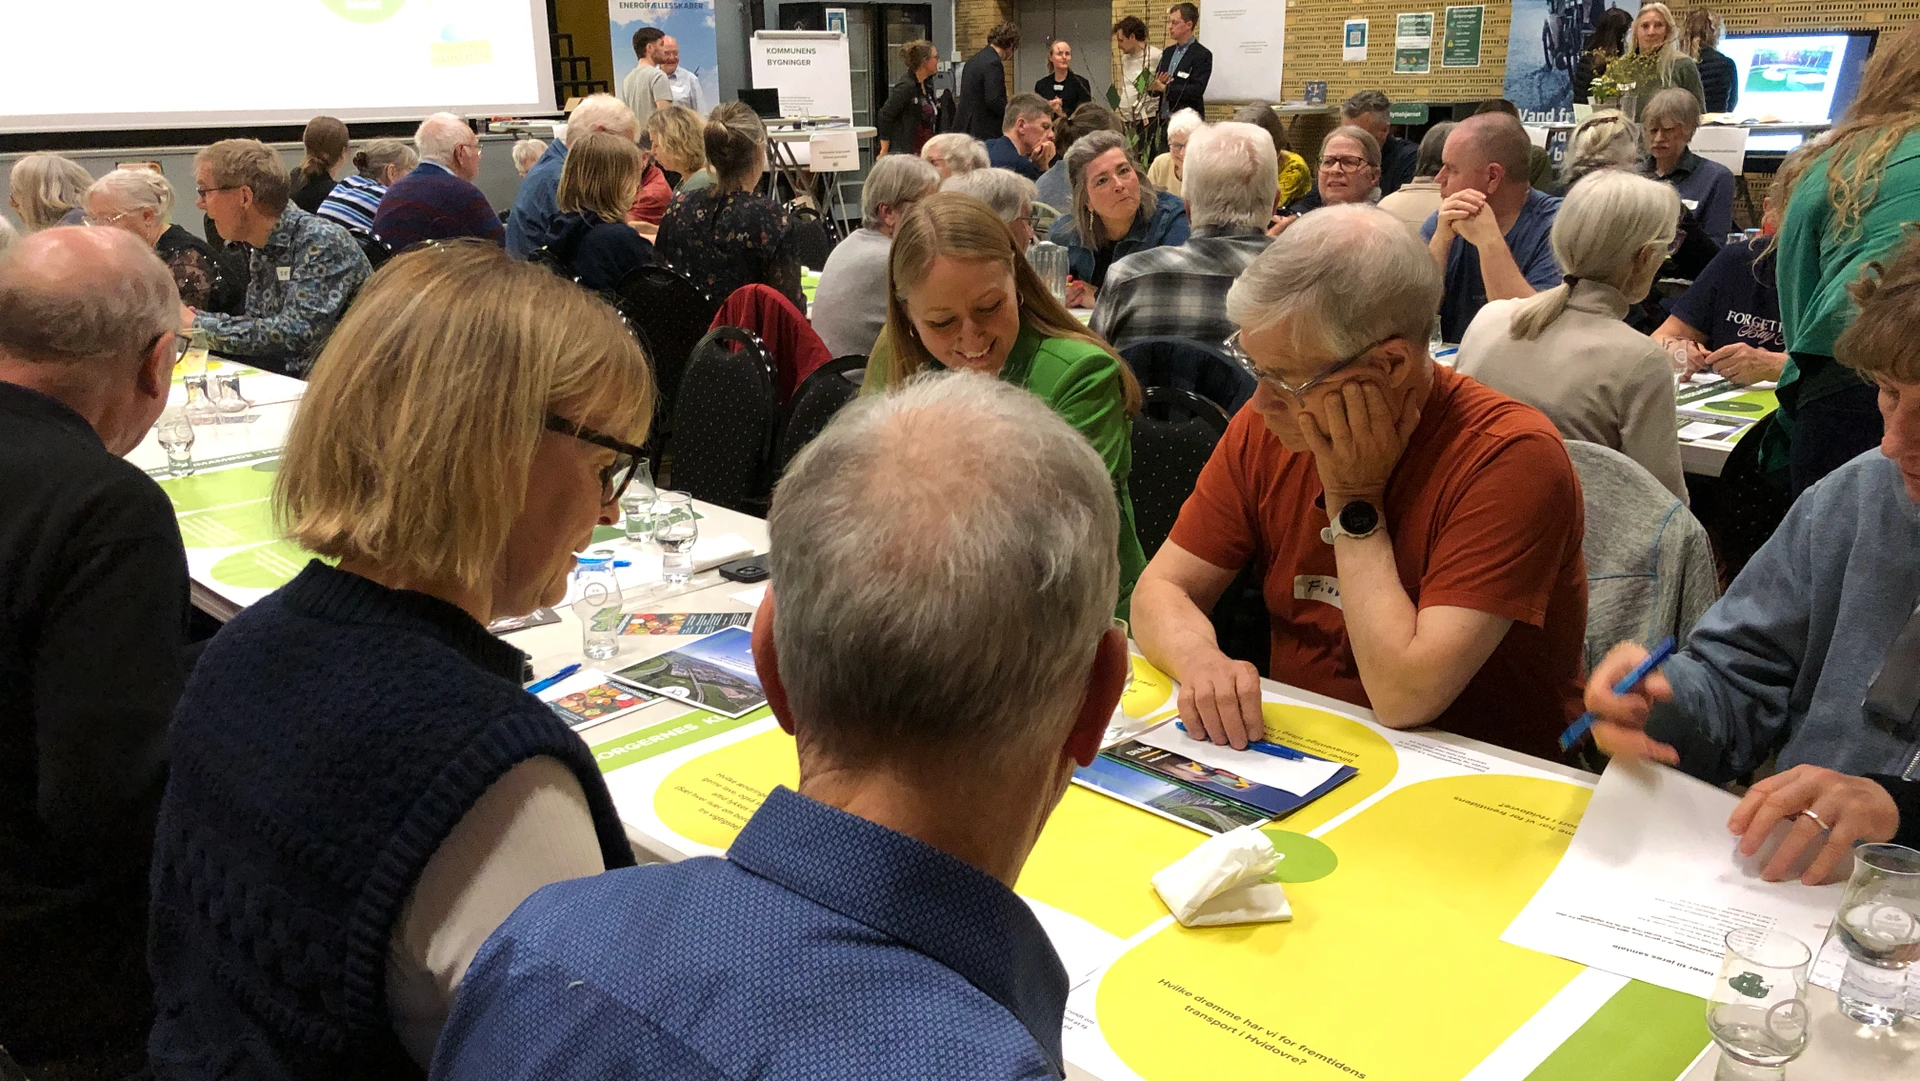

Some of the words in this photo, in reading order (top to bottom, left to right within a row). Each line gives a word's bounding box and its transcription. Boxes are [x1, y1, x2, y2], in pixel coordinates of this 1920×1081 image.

[1518, 108, 1554, 122] Vand
[1558, 108, 1575, 123] fr
[595, 722, 699, 763] ORGERNES
[1453, 796, 1508, 816] fremtidens
[1498, 802, 1551, 821] Hvidovre?
[1509, 813, 1524, 821] for
[1538, 822, 1556, 831] har
[1612, 944, 1650, 957] samtale
[1158, 978, 1193, 997] Hvilke
[1194, 994, 1242, 1022] drømme
[1242, 1018, 1264, 1032] har
[1266, 1029, 1278, 1038] vi
[1278, 1035, 1298, 1048] for
[1298, 1044, 1366, 1080] fremtidens
[1184, 1004, 1238, 1034] transport
[1244, 1034, 1308, 1066] Hvidovre?
